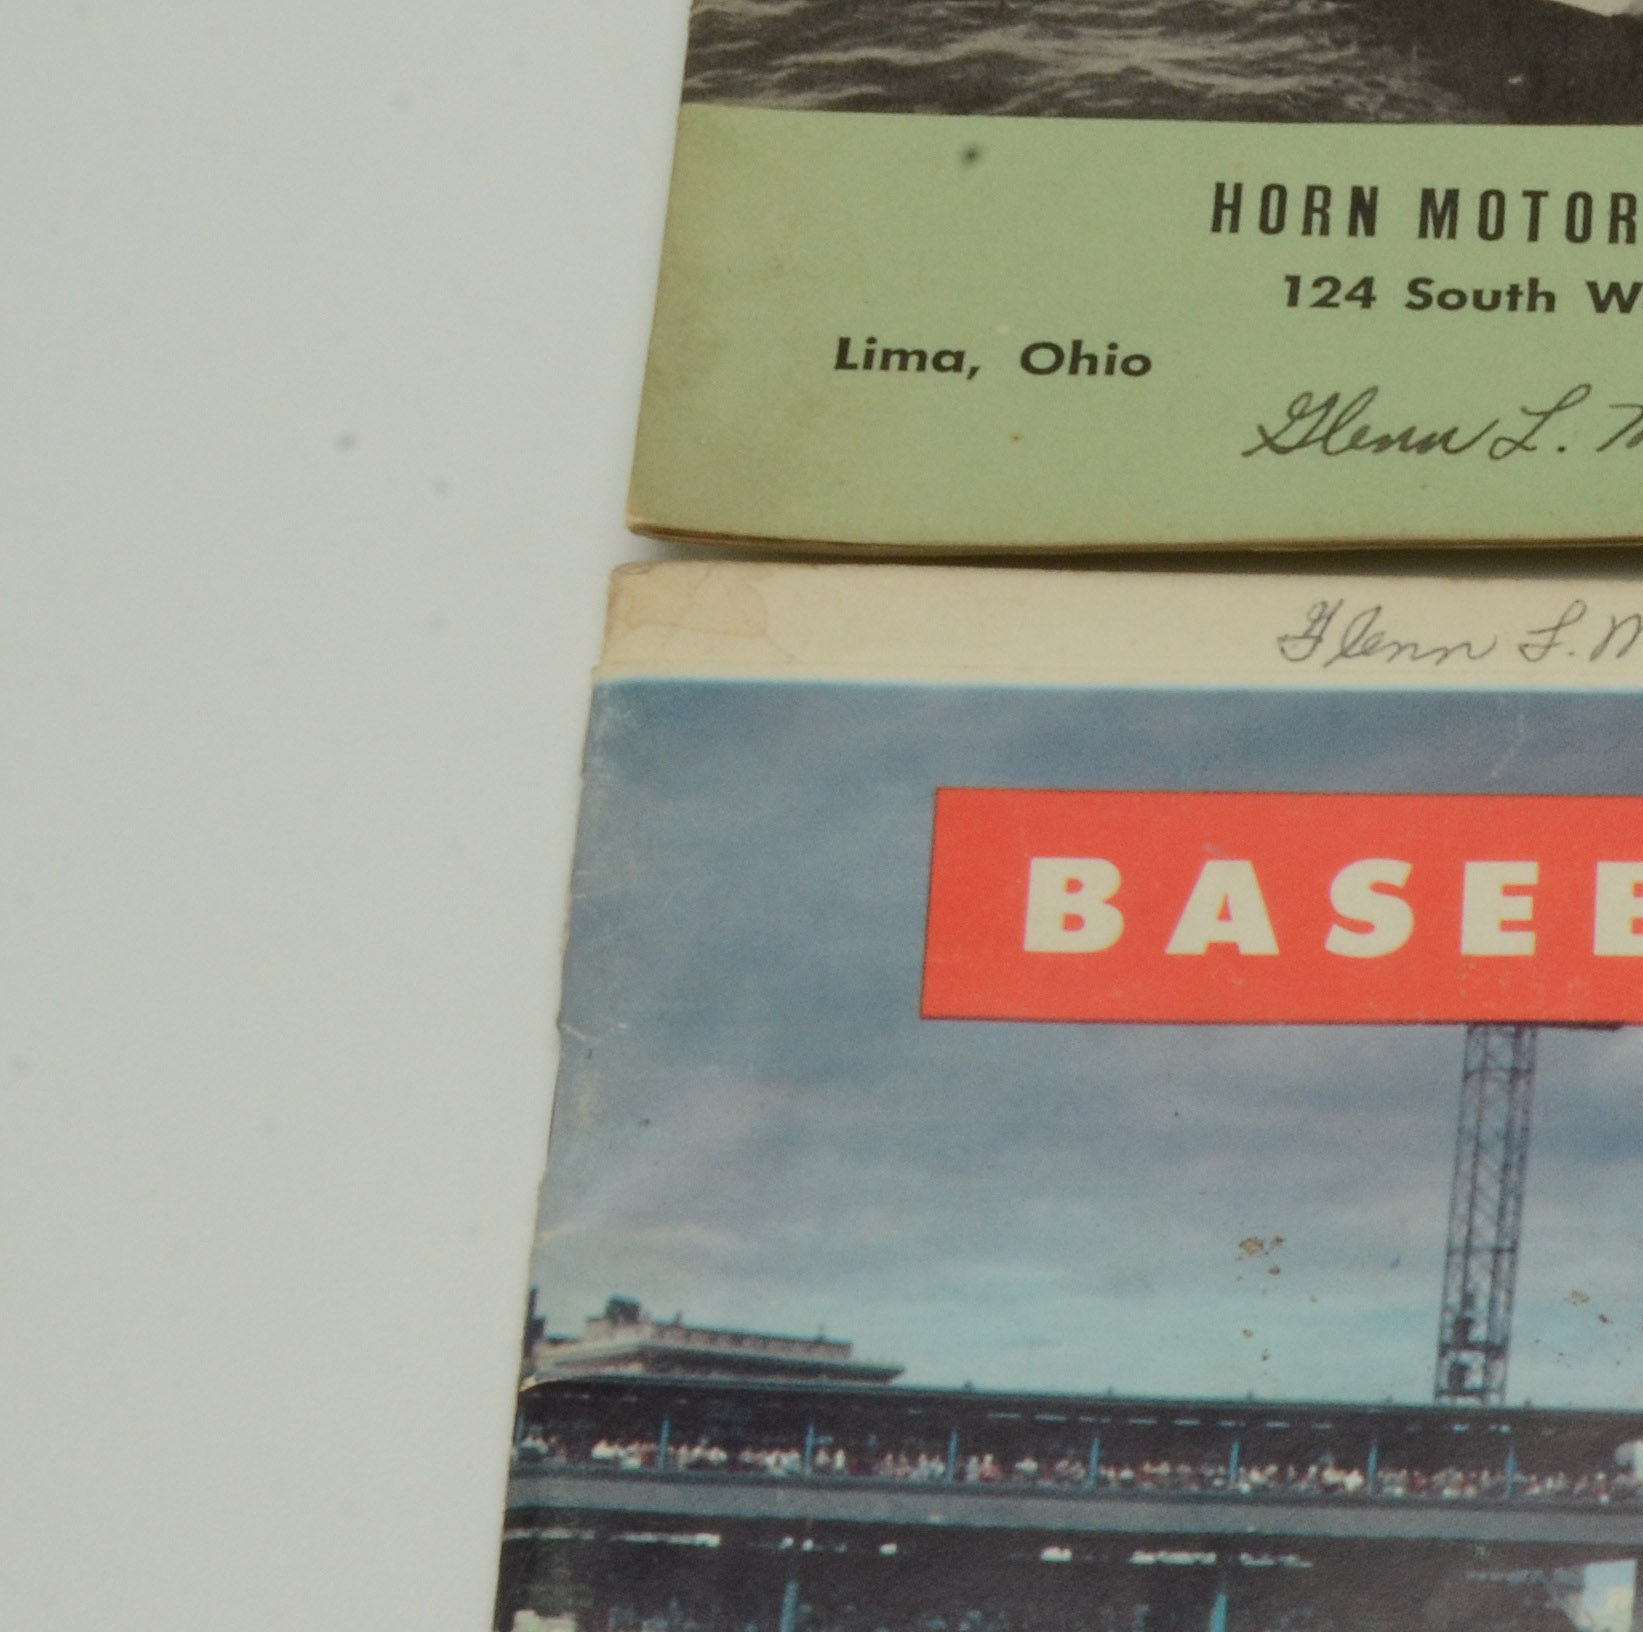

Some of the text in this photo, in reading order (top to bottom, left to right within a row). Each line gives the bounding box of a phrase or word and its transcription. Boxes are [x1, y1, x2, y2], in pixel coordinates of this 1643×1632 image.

[1210, 181, 1379, 238] HORN
[1417, 187, 1638, 245] MOTOR
[1284, 274, 1377, 310] 124
[1404, 276, 1557, 313] South
[833, 335, 1152, 381] Lima, Ohio
[1243, 387, 1498, 461] Glenn
[1277, 598, 1498, 668] Glenn
